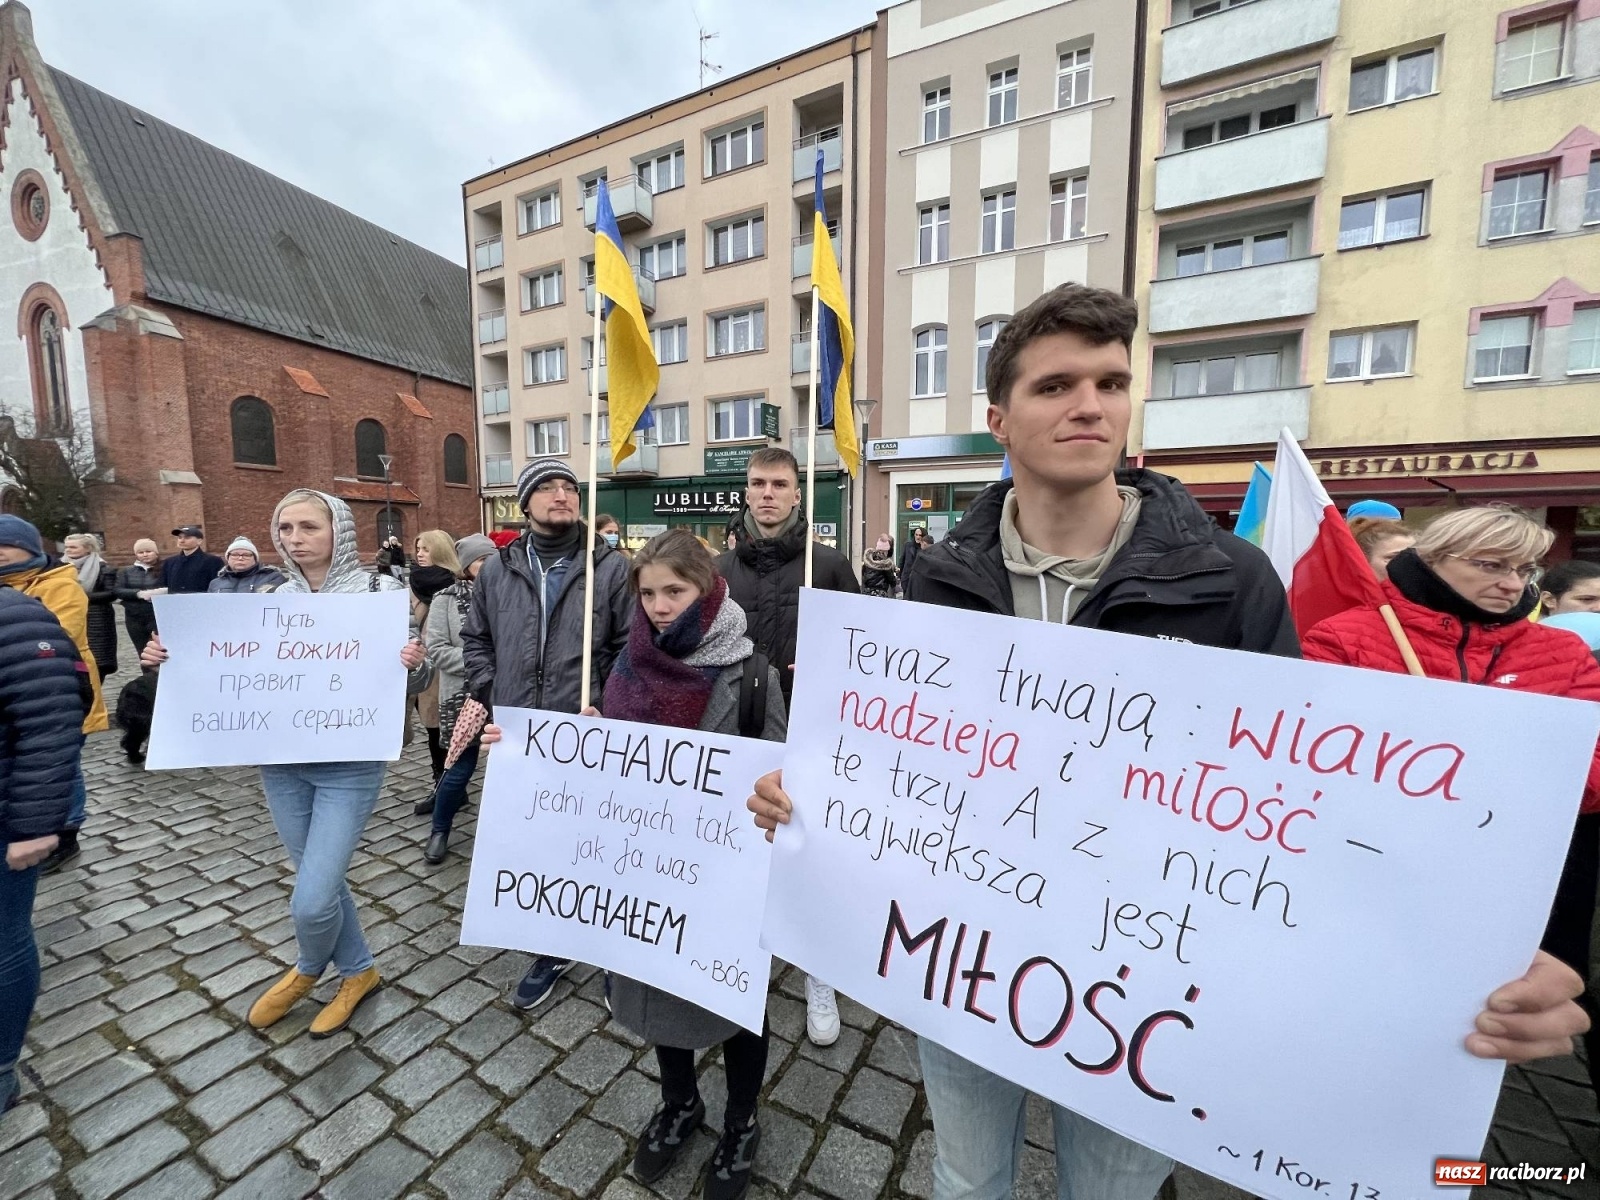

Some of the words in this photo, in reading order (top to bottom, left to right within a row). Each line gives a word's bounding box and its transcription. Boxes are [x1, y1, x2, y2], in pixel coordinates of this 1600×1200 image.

[1320, 452, 1540, 475] RESTAURACJA
[654, 491, 741, 506] JUBILER
[262, 607, 315, 637] Пусть
[210, 641, 260, 658] МИР
[277, 638, 360, 660] БОЖИЙ
[843, 627, 953, 688] Teraz
[220, 673, 306, 700] правит
[192, 710, 271, 733] ваших
[292, 707, 379, 734] сердцах
[525, 718, 731, 797] KOCHAJCIE
[840, 690, 1020, 778] nadzieja
[1060, 741, 1078, 782] i
[1123, 761, 1323, 854] miłość
[525, 781, 585, 820] jedni
[598, 790, 675, 837] drugich
[696, 804, 742, 853] tak,
[832, 734, 862, 782] te
[1003, 786, 1040, 839] A
[1072, 821, 1108, 858] z
[1163, 846, 1298, 927] nich
[571, 832, 606, 866] jak
[656, 854, 700, 885] was
[825, 796, 1046, 908] największa
[1091, 879, 1198, 964] jest
[494, 869, 687, 955] POKOCHAŁEM
[1275, 1155, 1332, 1197] Kor.
